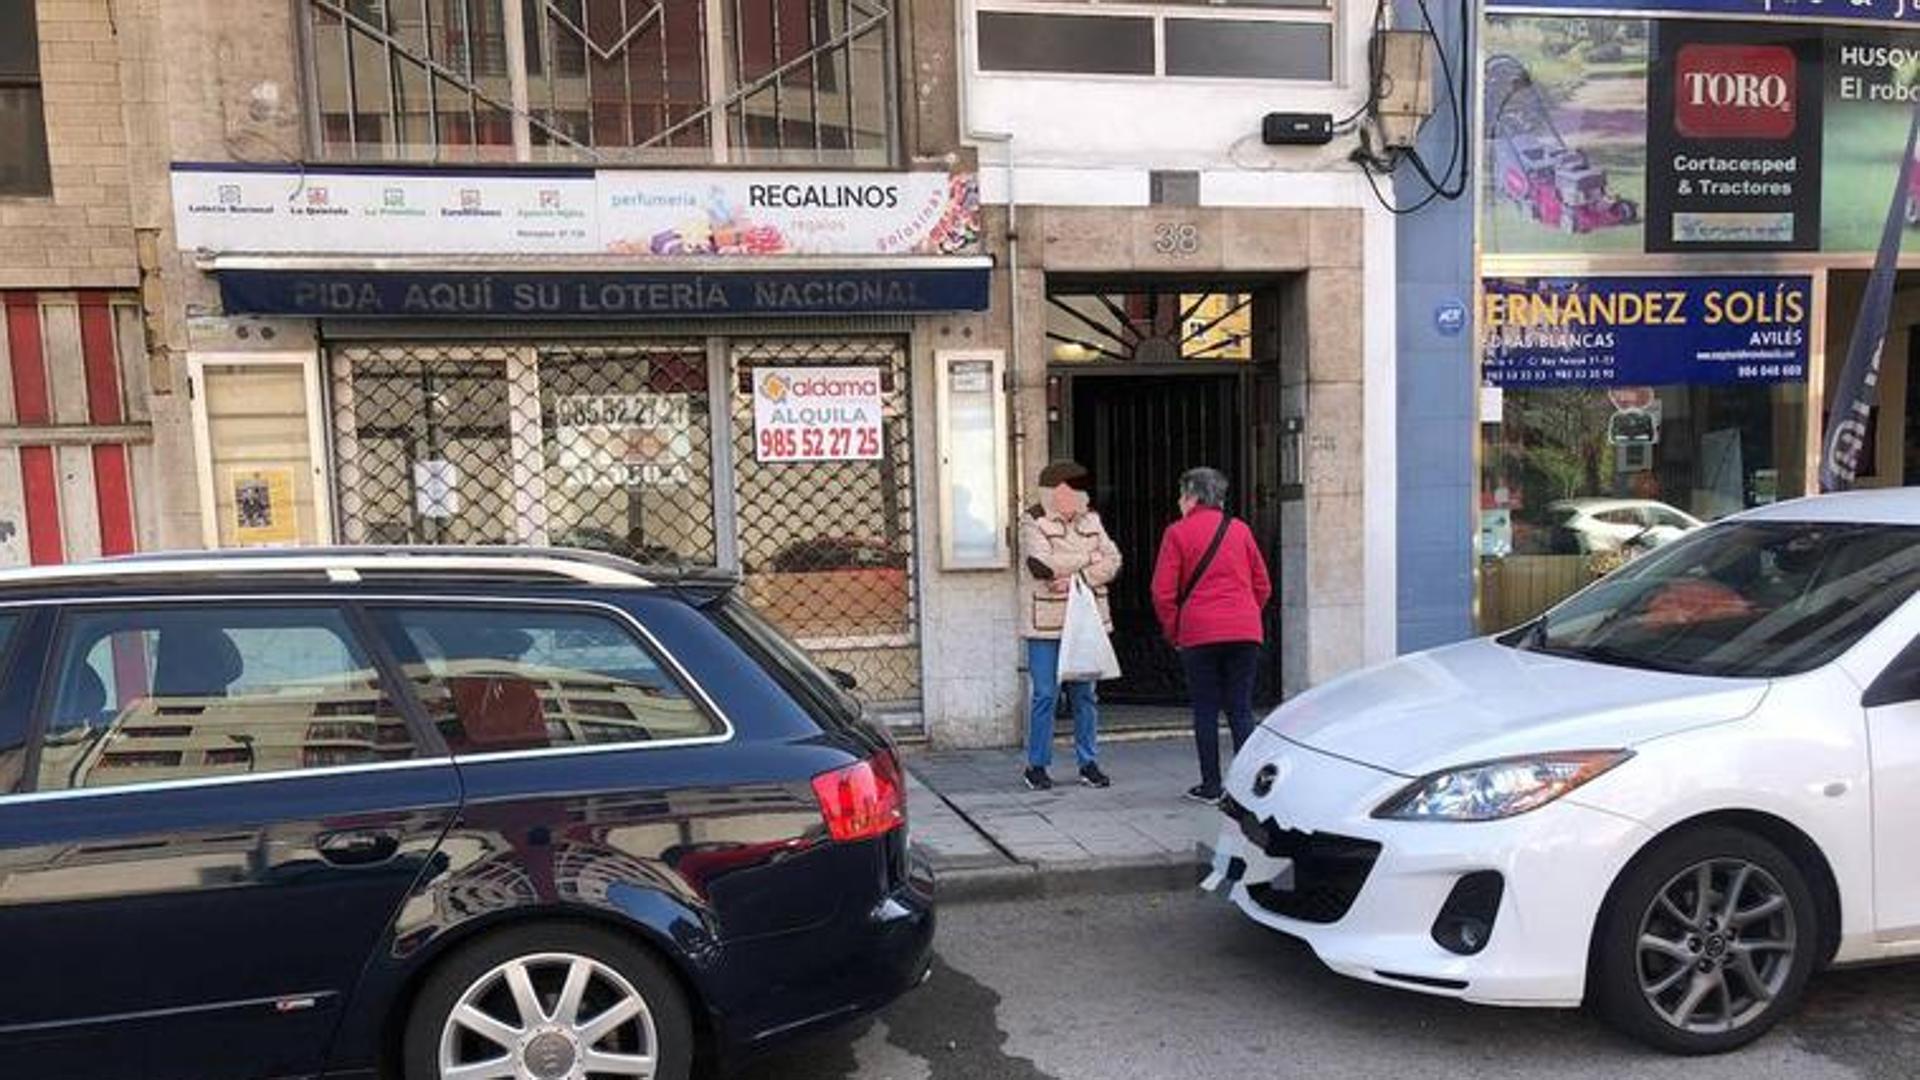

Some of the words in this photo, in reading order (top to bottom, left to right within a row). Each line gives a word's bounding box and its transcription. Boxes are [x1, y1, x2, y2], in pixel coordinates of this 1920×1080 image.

[1684, 72, 1789, 109] TORO
[1840, 76, 1862, 99] El
[749, 184, 899, 208] REGALINOS
[1678, 179, 1692, 195] &
[1698, 179, 1792, 196] Tractores
[1154, 223, 1197, 253] 38
[296, 283, 381, 310] PIDA
[403, 277, 492, 311] AQUÍ
[513, 283, 561, 310] SU
[578, 276, 729, 310] LOTERÍA
[753, 280, 923, 307] NACIONAL
[1703, 283, 1804, 324] SOLÍS
[792, 377, 877, 397] aldama
[770, 407, 868, 425] ALQUILA
[760, 428, 797, 457] 985
[801, 428, 824, 456] 52
[828, 427, 852, 455] 27
[857, 427, 880, 455] 25
